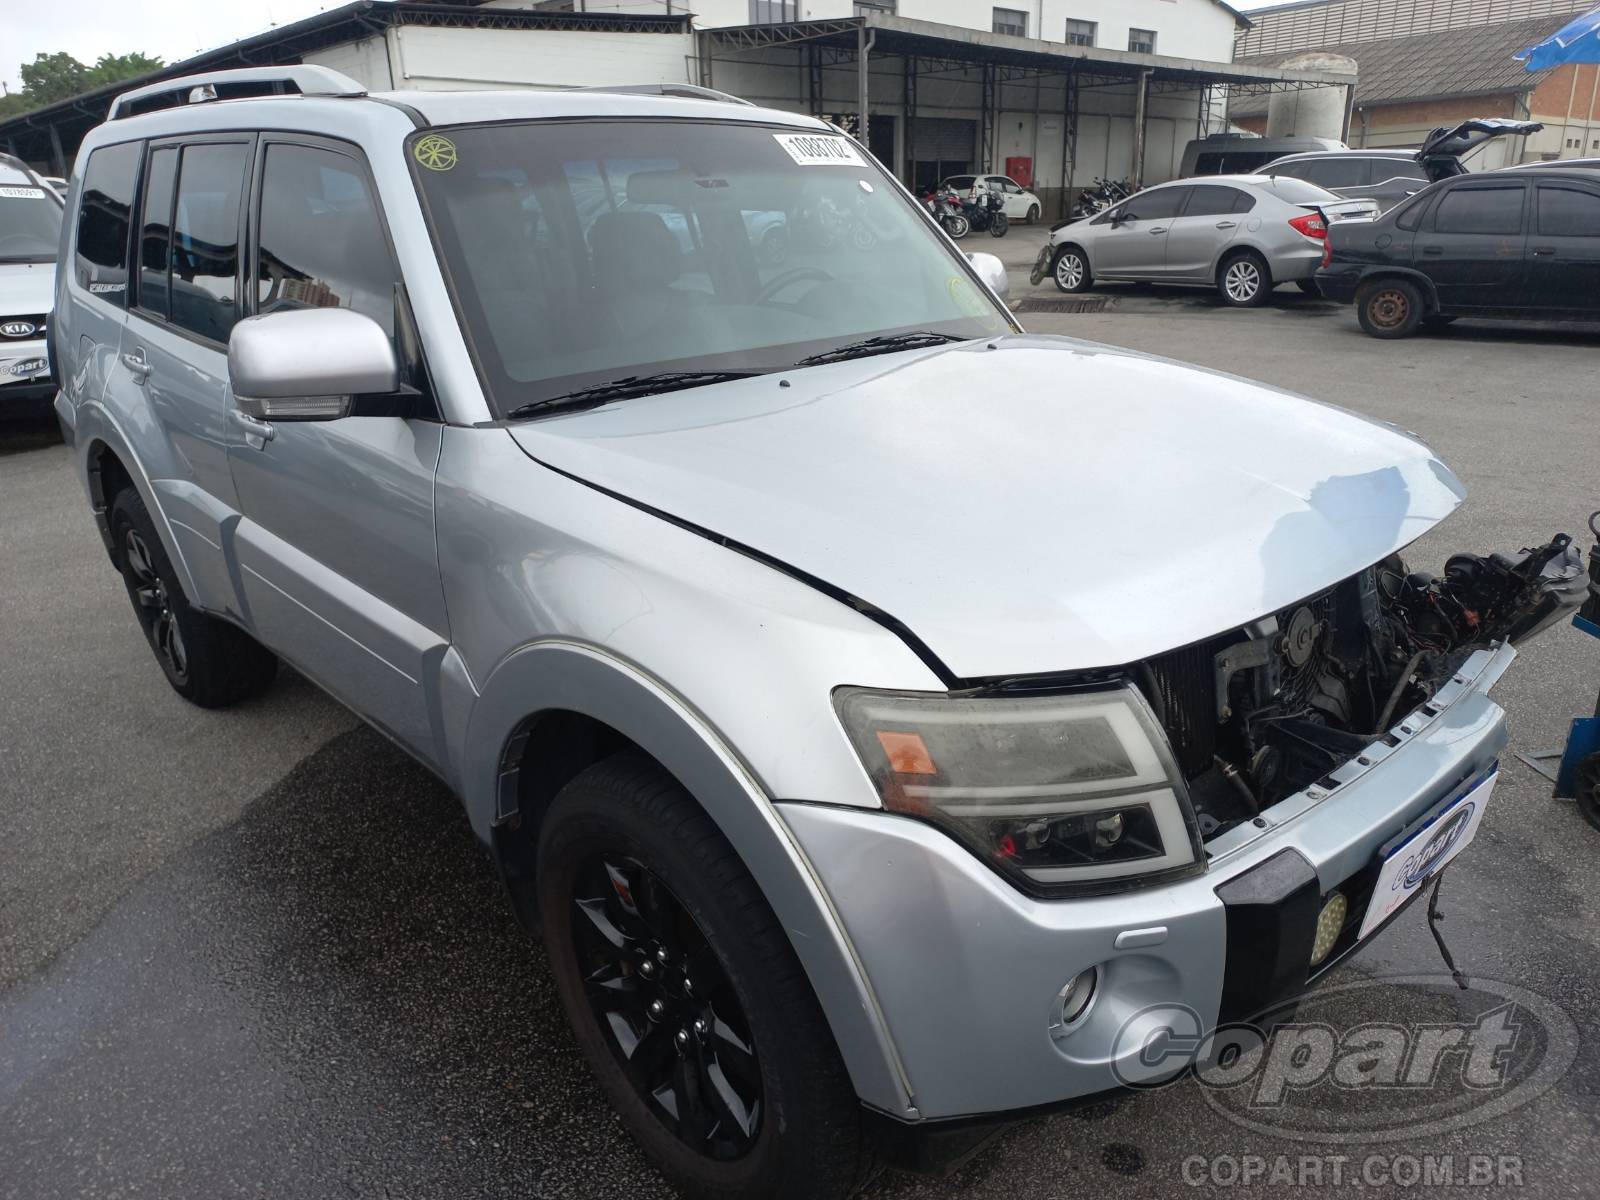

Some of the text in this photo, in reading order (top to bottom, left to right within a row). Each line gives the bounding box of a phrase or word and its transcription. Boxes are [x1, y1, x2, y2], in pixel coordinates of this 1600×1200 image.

[788, 136, 852, 159] 1088702
[5, 324, 30, 334] KIA
[1391, 808, 1467, 890] Copart
